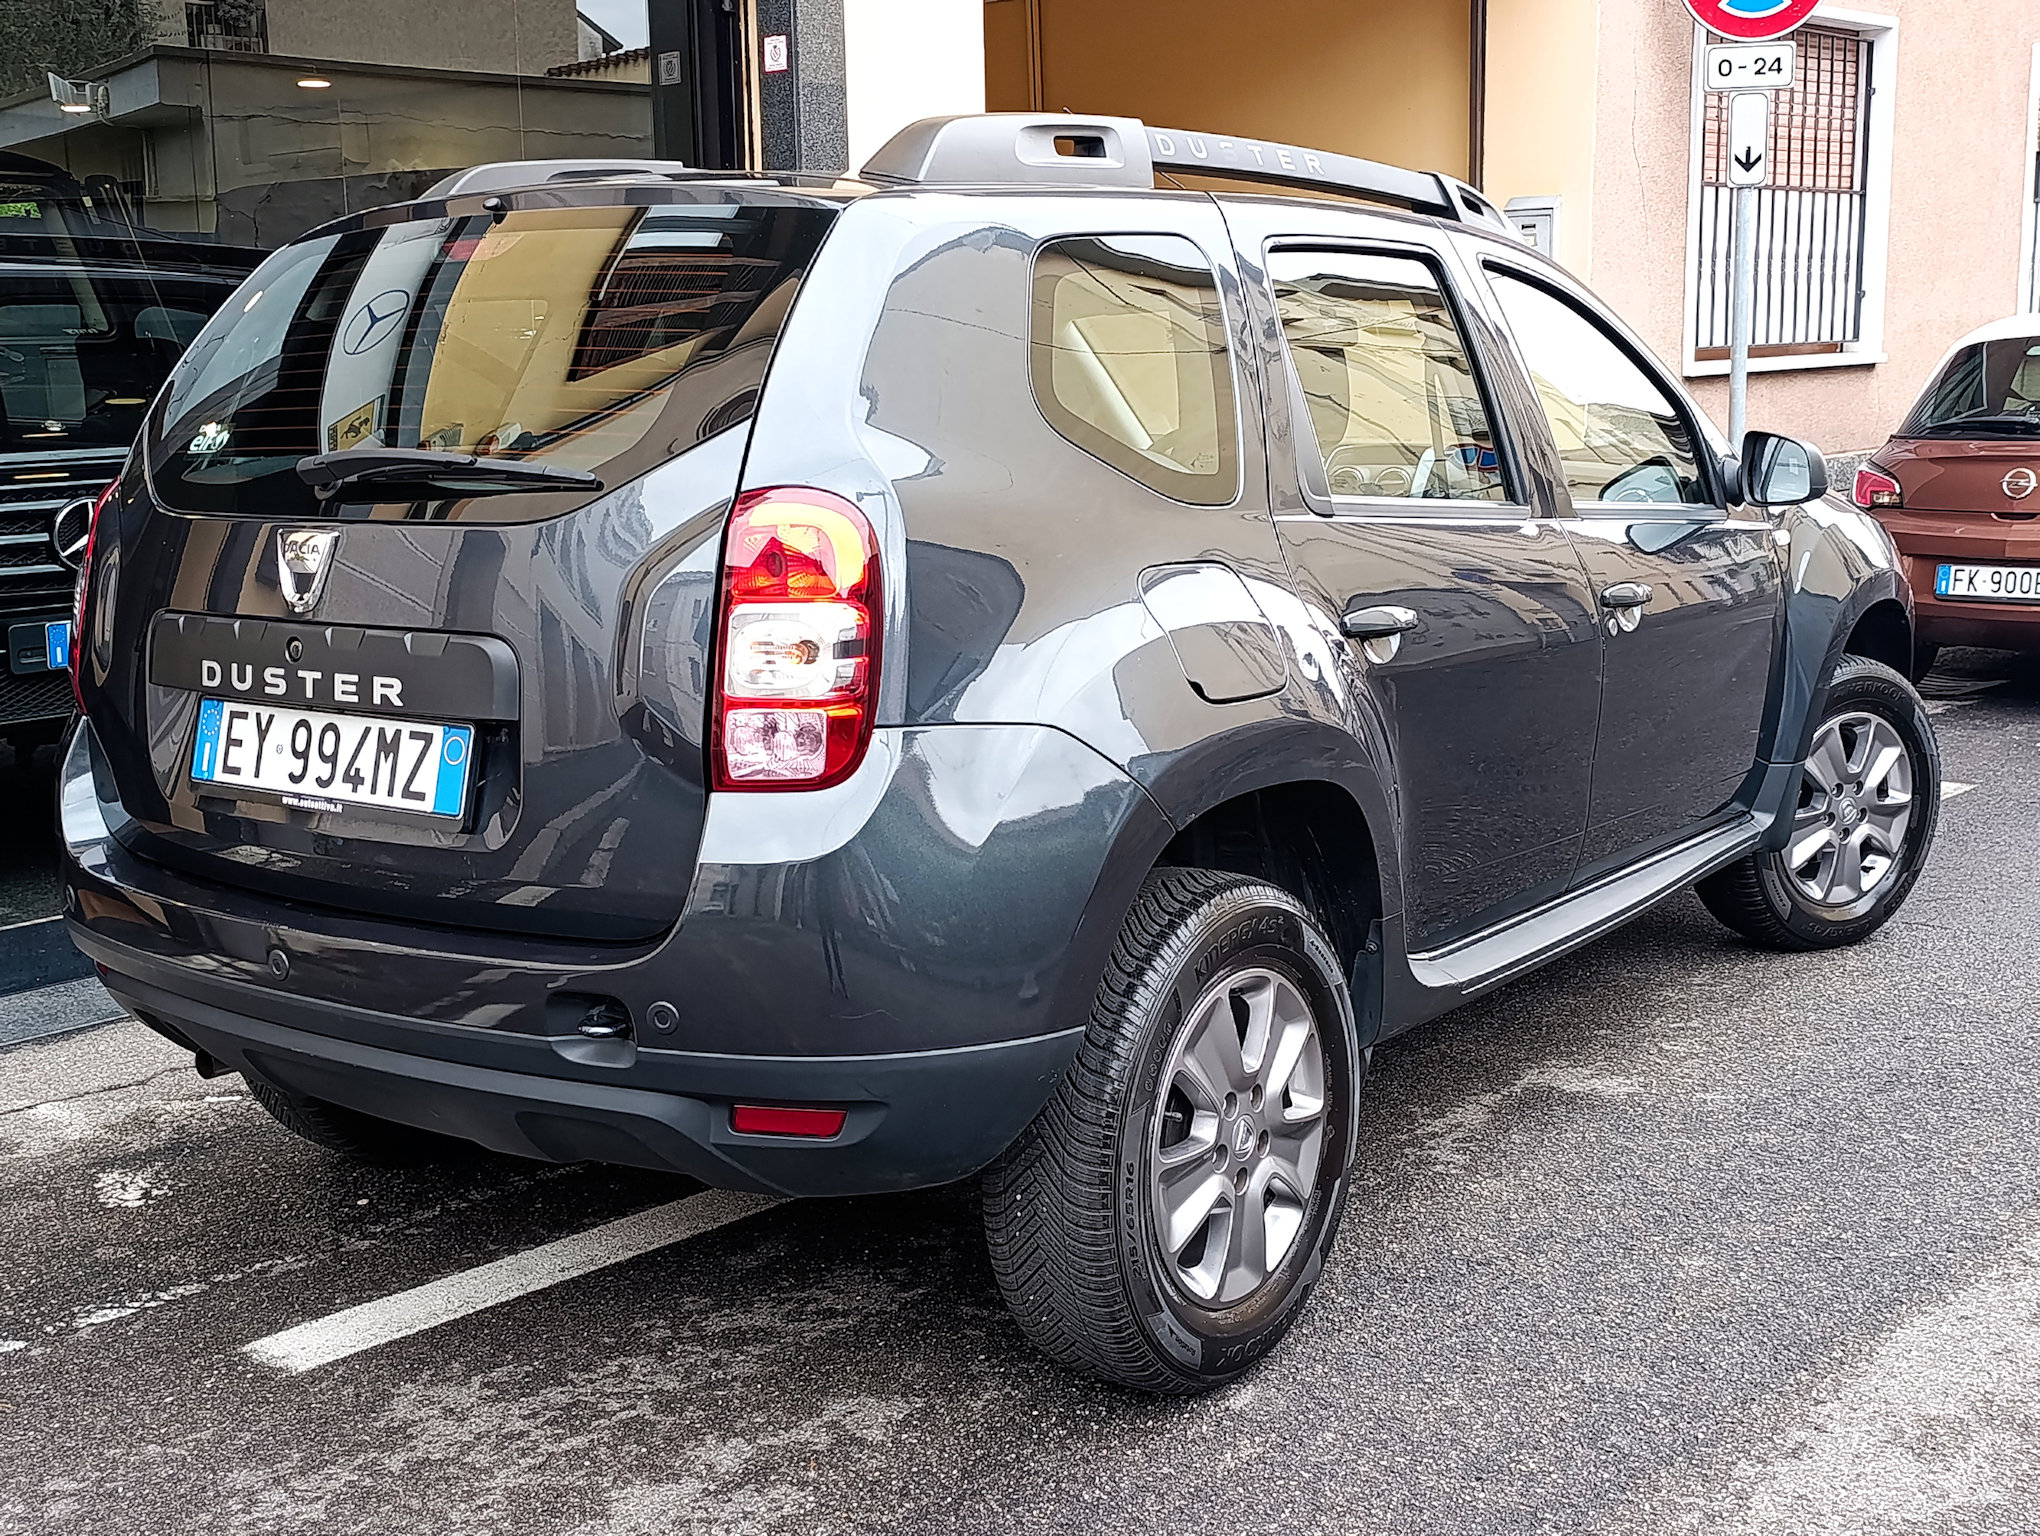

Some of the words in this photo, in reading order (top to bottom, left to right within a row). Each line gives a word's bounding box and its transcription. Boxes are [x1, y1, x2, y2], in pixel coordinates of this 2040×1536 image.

[1718, 59, 1732, 77] 0
[1754, 57, 1783, 76] 24
[1952, 569, 1980, 593] FK
[202, 660, 403, 707] DUSTER
[222, 711, 275, 779] EY
[288, 718, 434, 802] 994MZ
